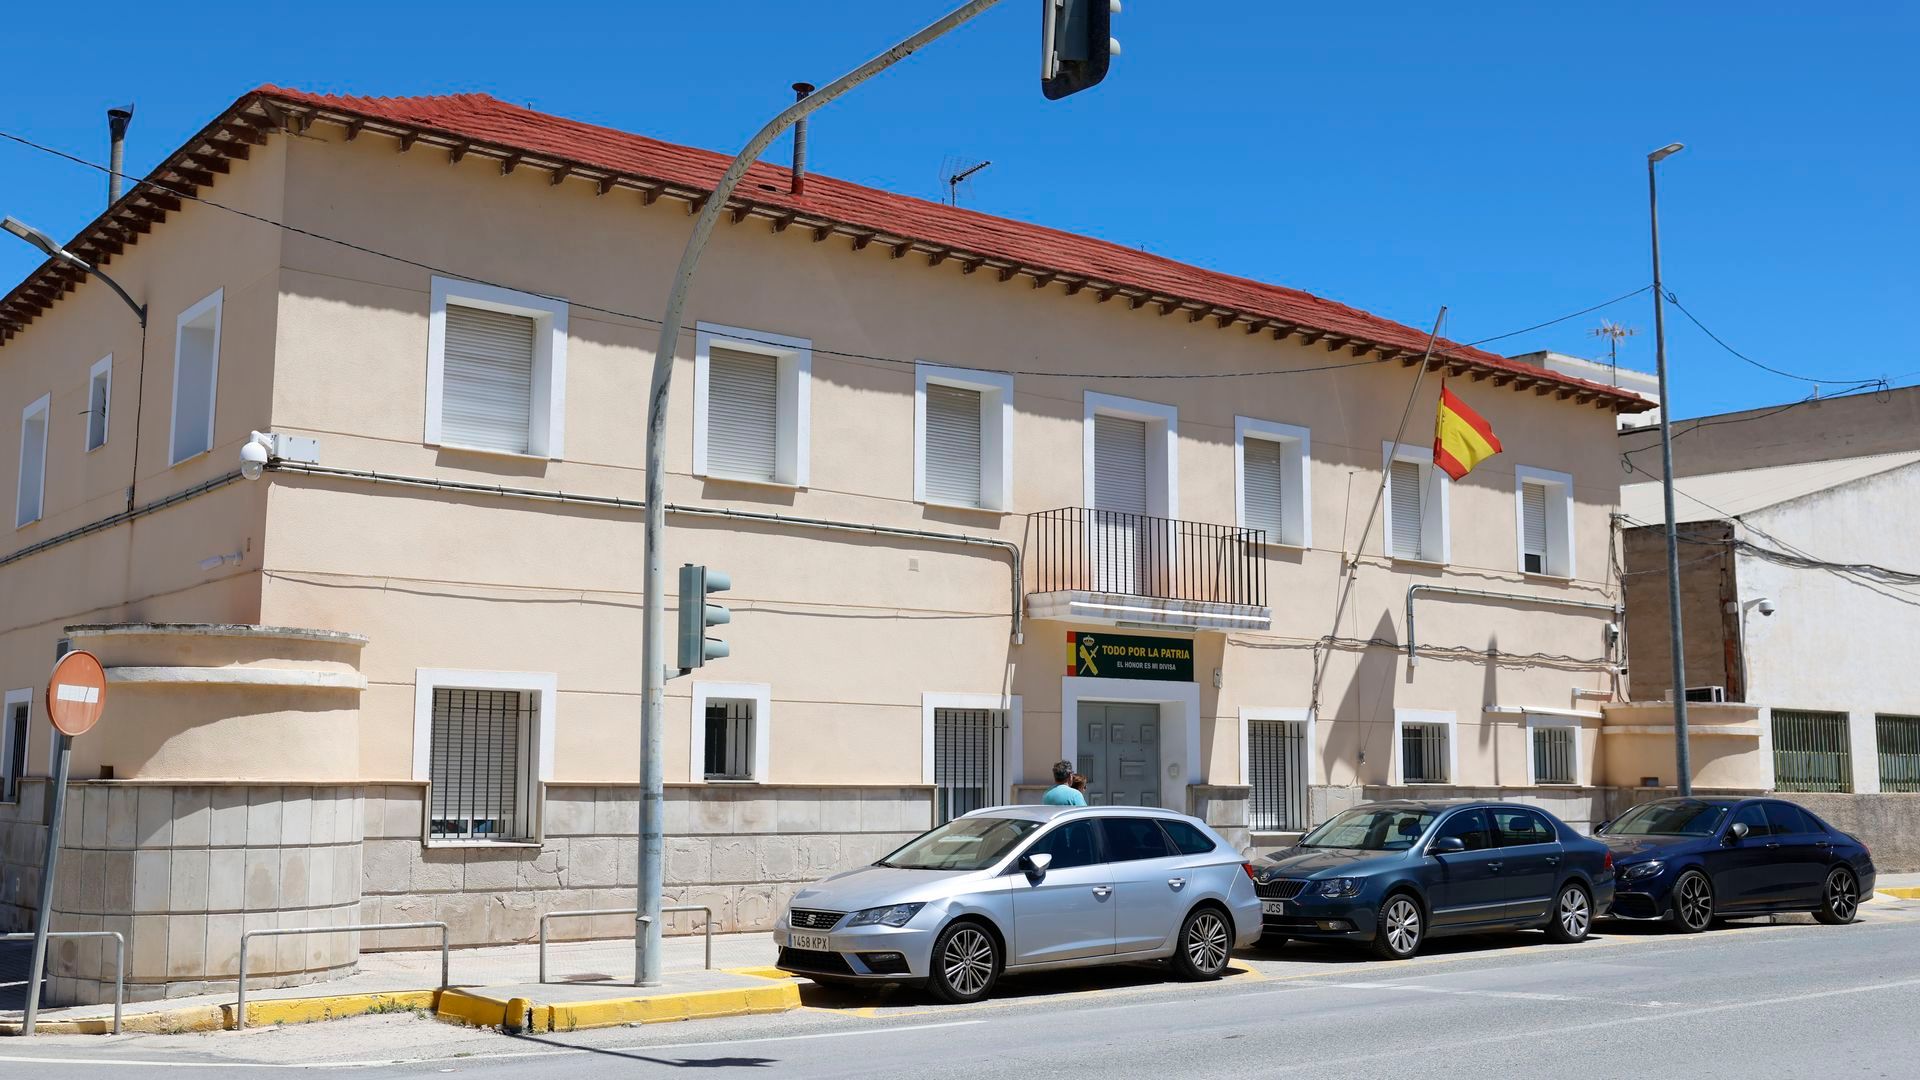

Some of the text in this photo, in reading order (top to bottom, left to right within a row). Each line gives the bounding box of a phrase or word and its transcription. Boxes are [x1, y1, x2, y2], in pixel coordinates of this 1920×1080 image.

[1102, 645, 1190, 659] TODO POR LA PATRIA
[1125, 661, 1143, 669] HONOR
[1152, 662, 1158, 670] MI
[1266, 903, 1281, 913] JCS
[793, 935, 827, 950] 1458 KPX
